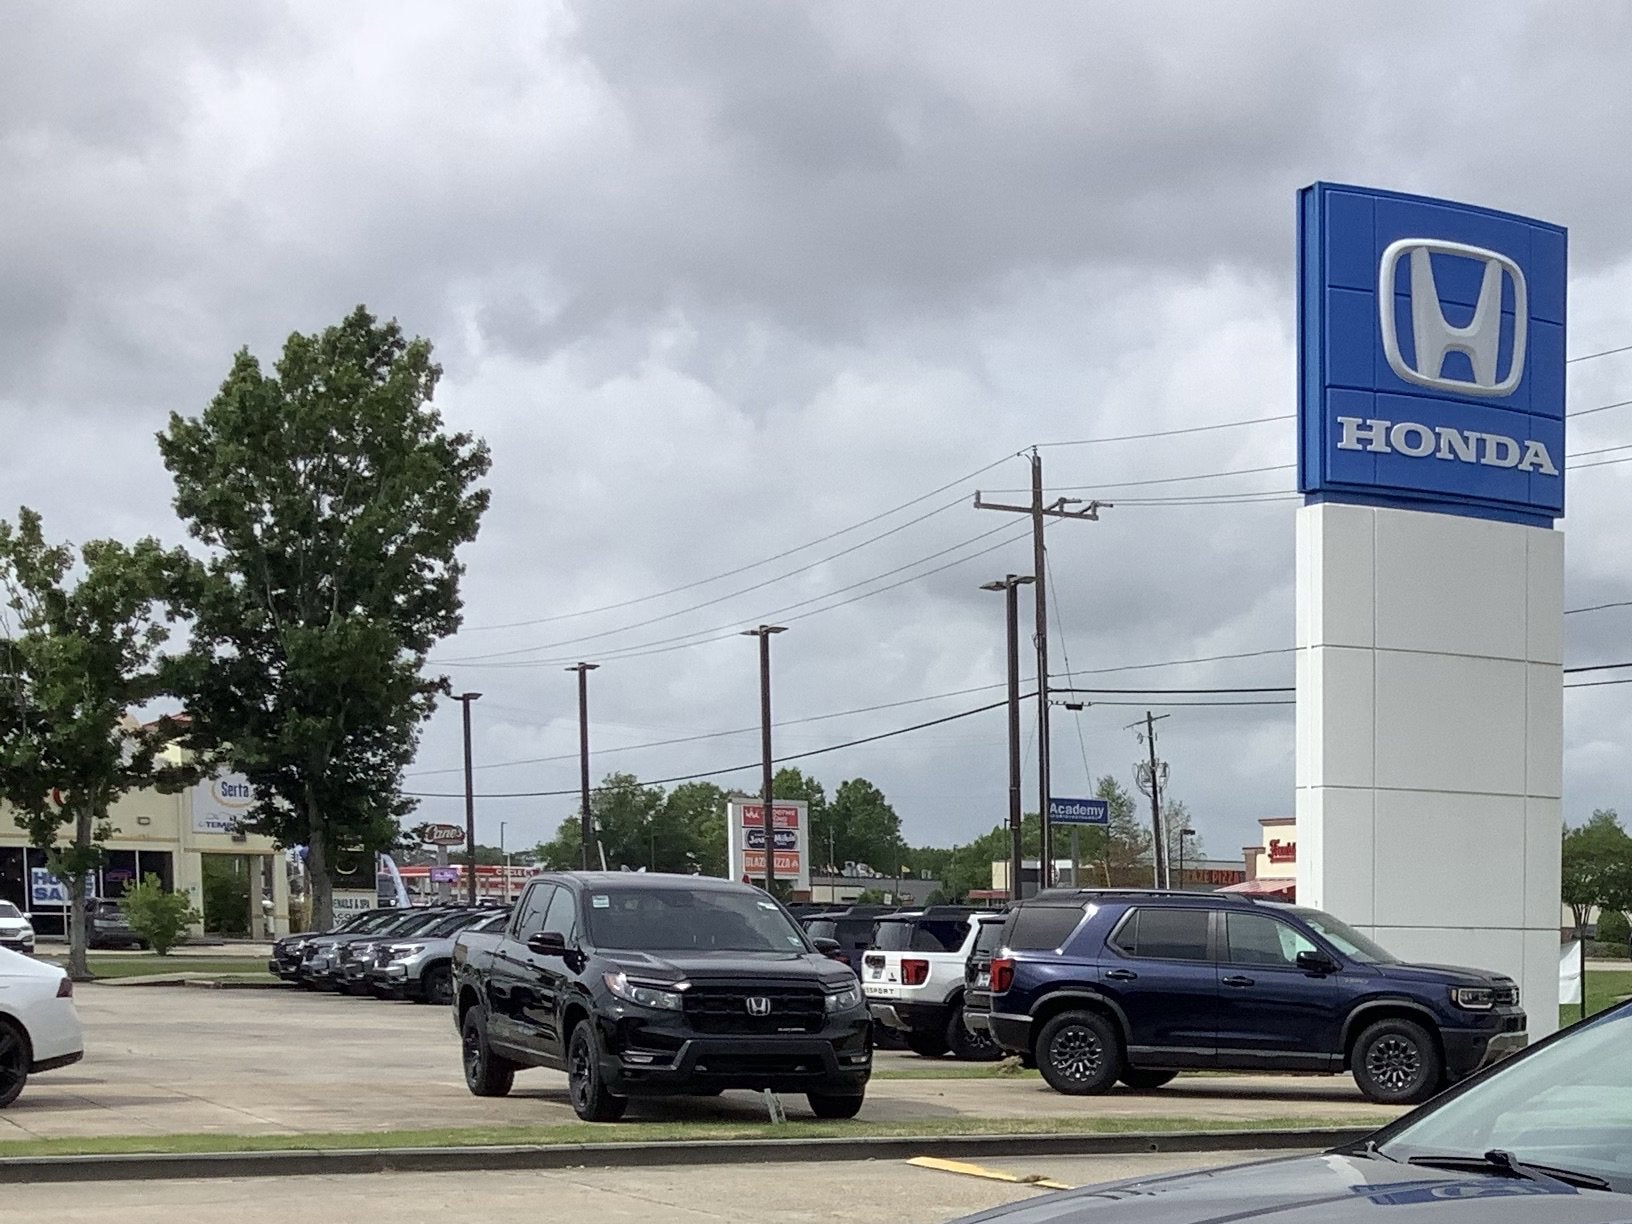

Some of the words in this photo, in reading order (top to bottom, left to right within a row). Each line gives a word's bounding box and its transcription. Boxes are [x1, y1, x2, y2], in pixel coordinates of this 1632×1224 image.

[1337, 416, 1558, 476] HONDA
[221, 781, 249, 798] Serta
[1049, 803, 1104, 820] Academy
[424, 825, 463, 843] Cane's
